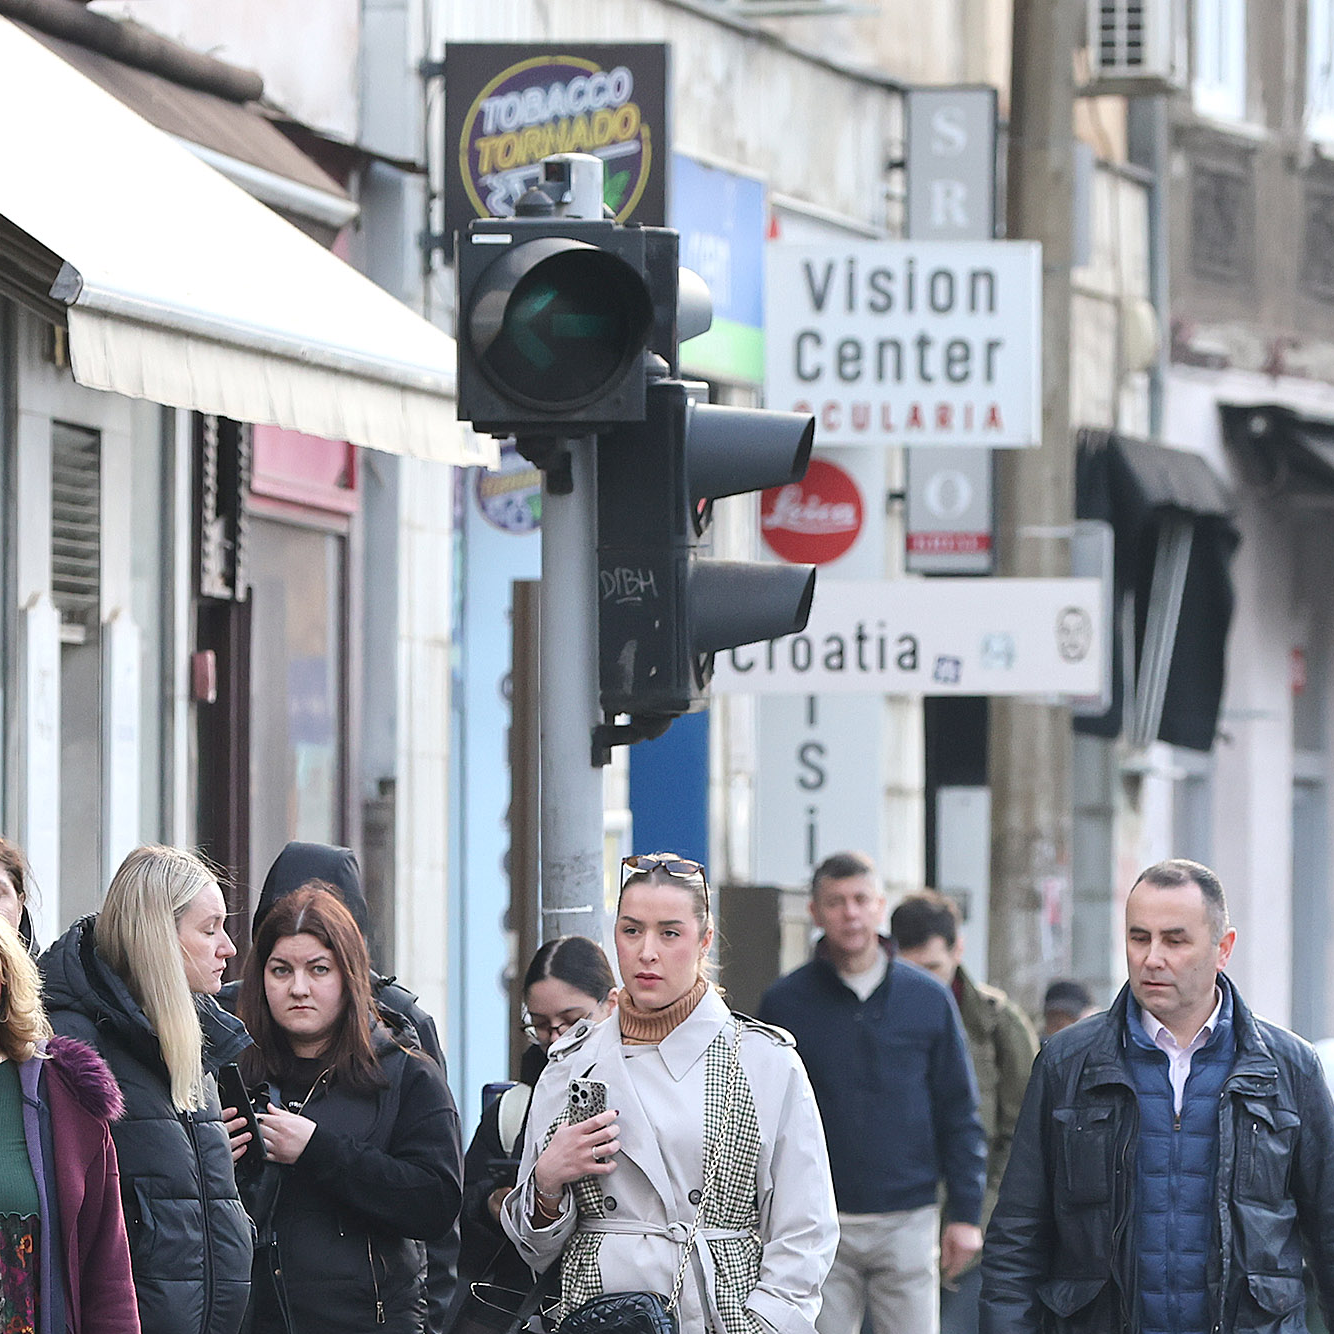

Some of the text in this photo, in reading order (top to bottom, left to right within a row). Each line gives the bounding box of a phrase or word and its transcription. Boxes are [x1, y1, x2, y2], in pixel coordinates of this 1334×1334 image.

[479, 66, 634, 135] TOBACCO
[475, 103, 641, 176] TORNADO
[801, 256, 997, 313] Vision
[793, 330, 1005, 383] Center
